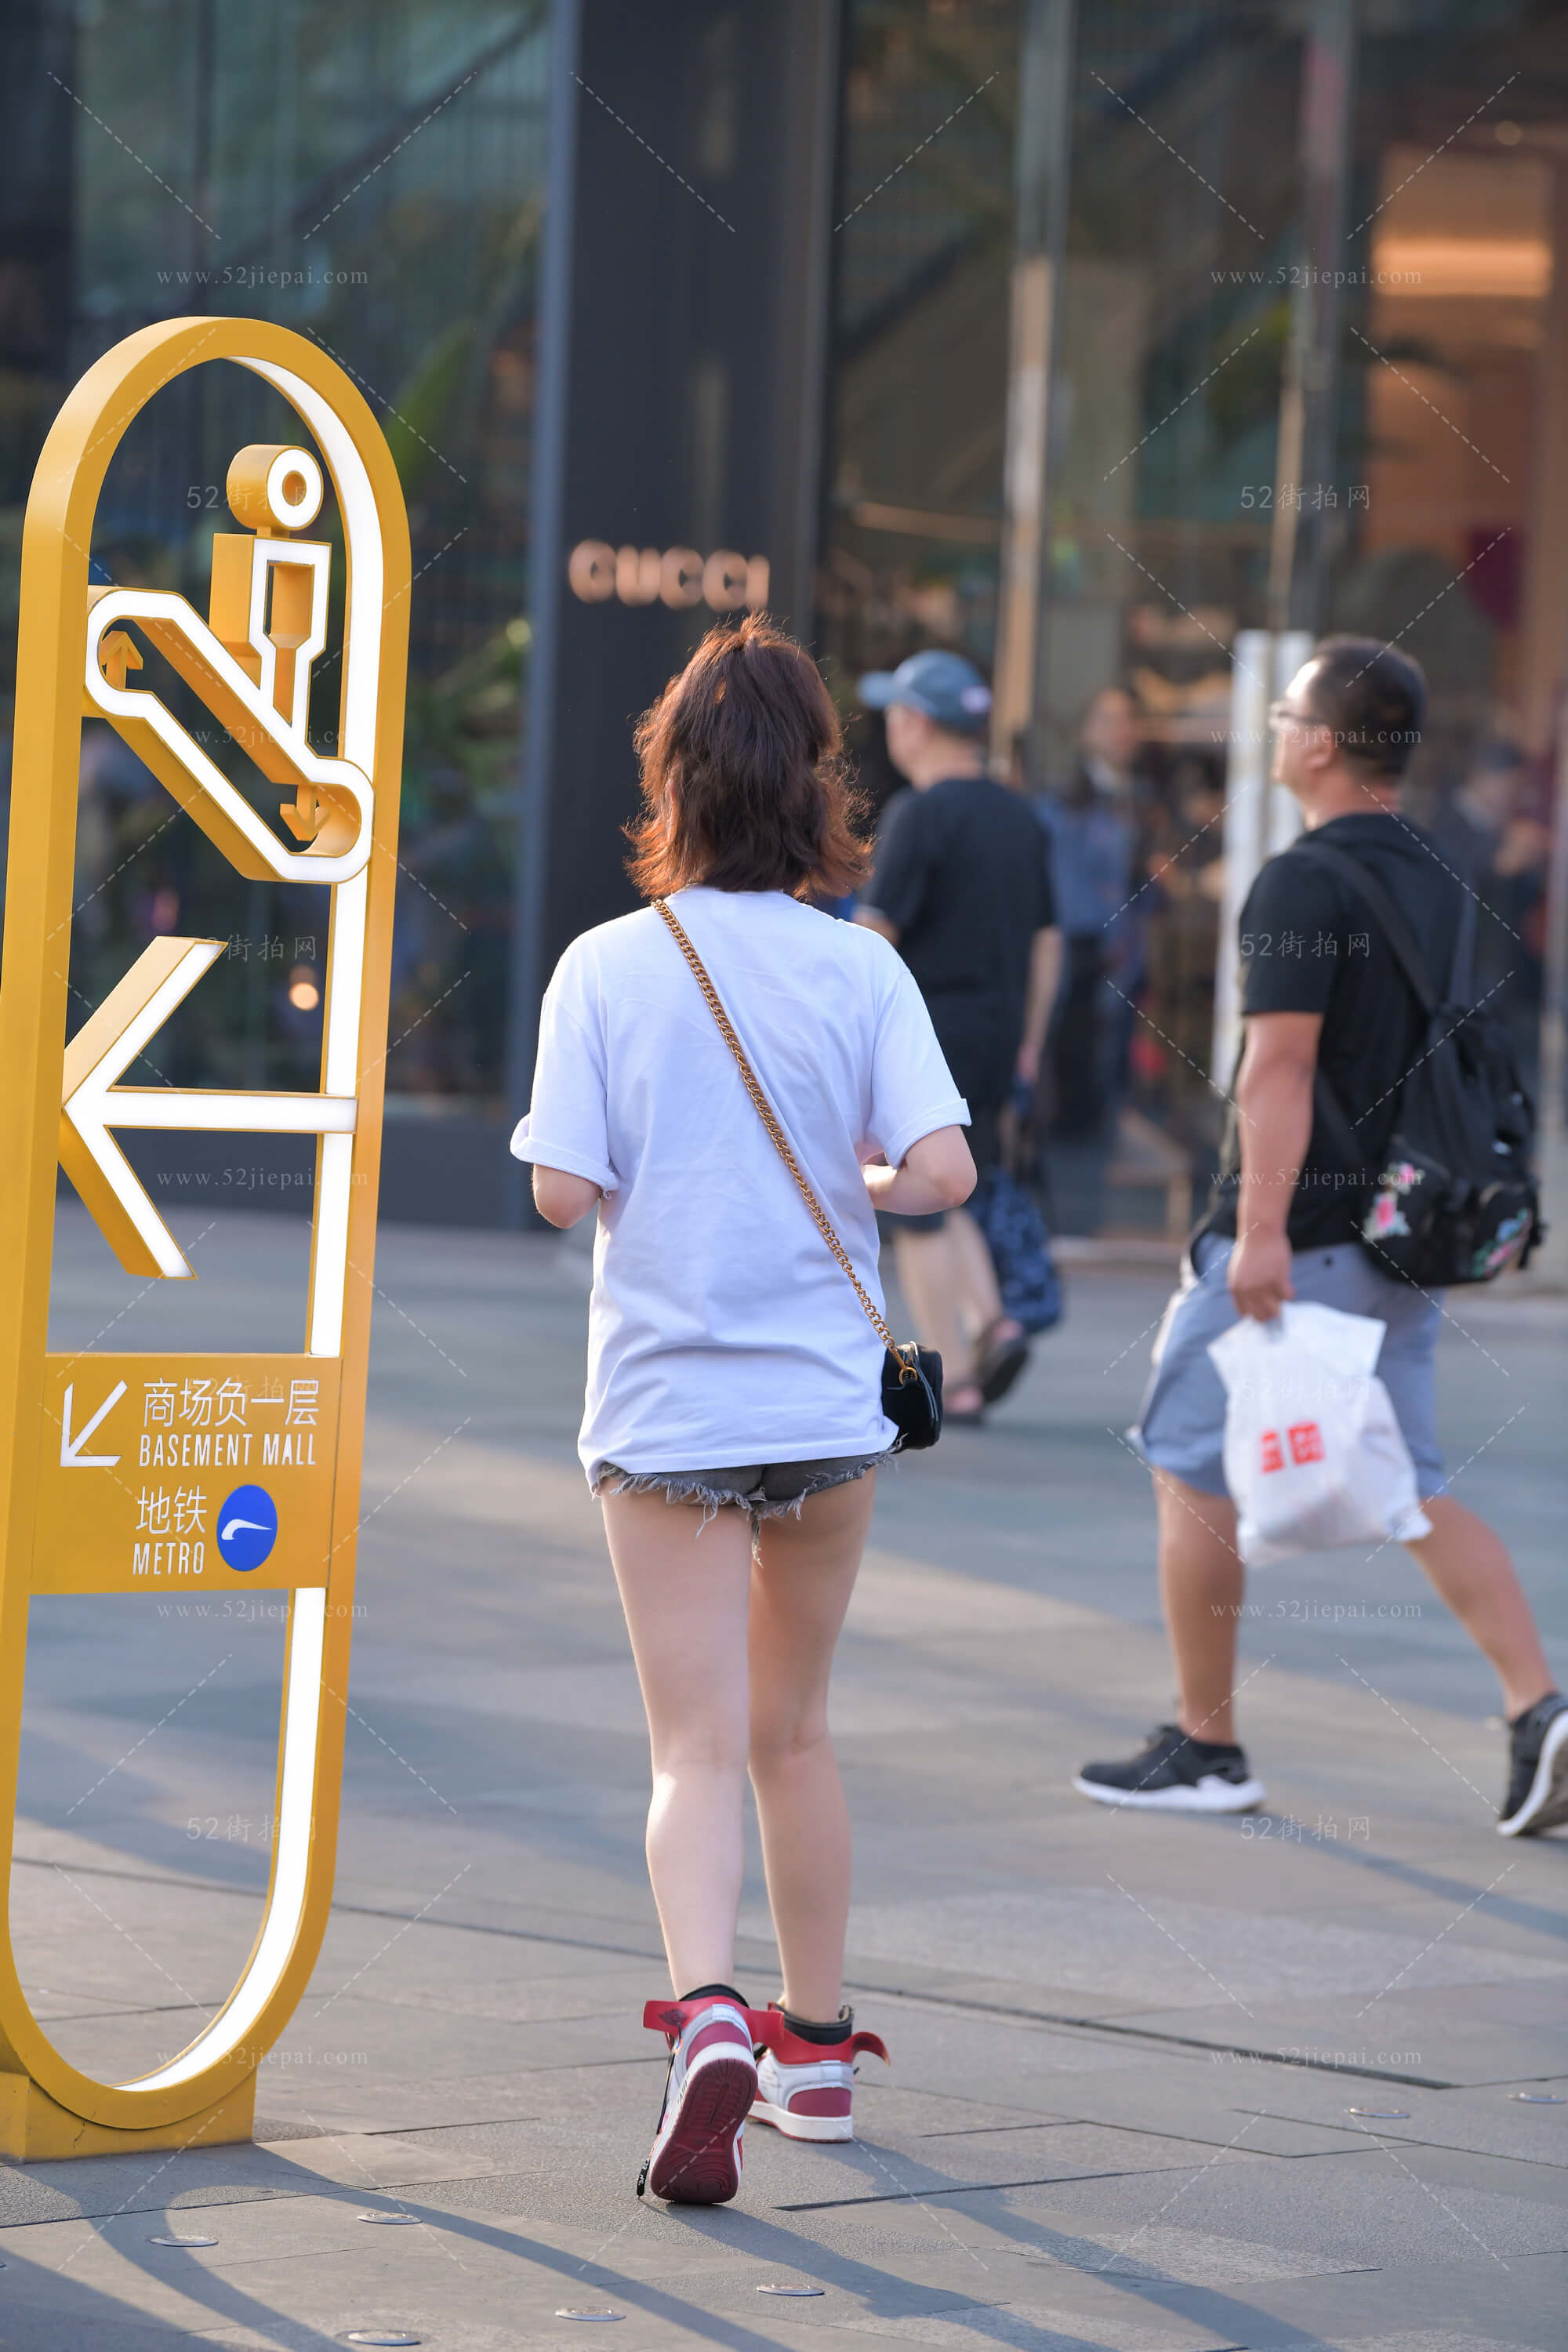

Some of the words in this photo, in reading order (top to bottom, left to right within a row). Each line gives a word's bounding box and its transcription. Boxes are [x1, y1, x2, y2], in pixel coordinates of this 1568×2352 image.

[568, 538, 771, 612] GUCCI
[143, 1377, 320, 1428] 商场负一层
[139, 1433, 253, 1468] BASEMENT
[262, 1433, 317, 1466] MALL
[134, 1484, 208, 1535] 地铁
[132, 1541, 205, 1576] METRO
